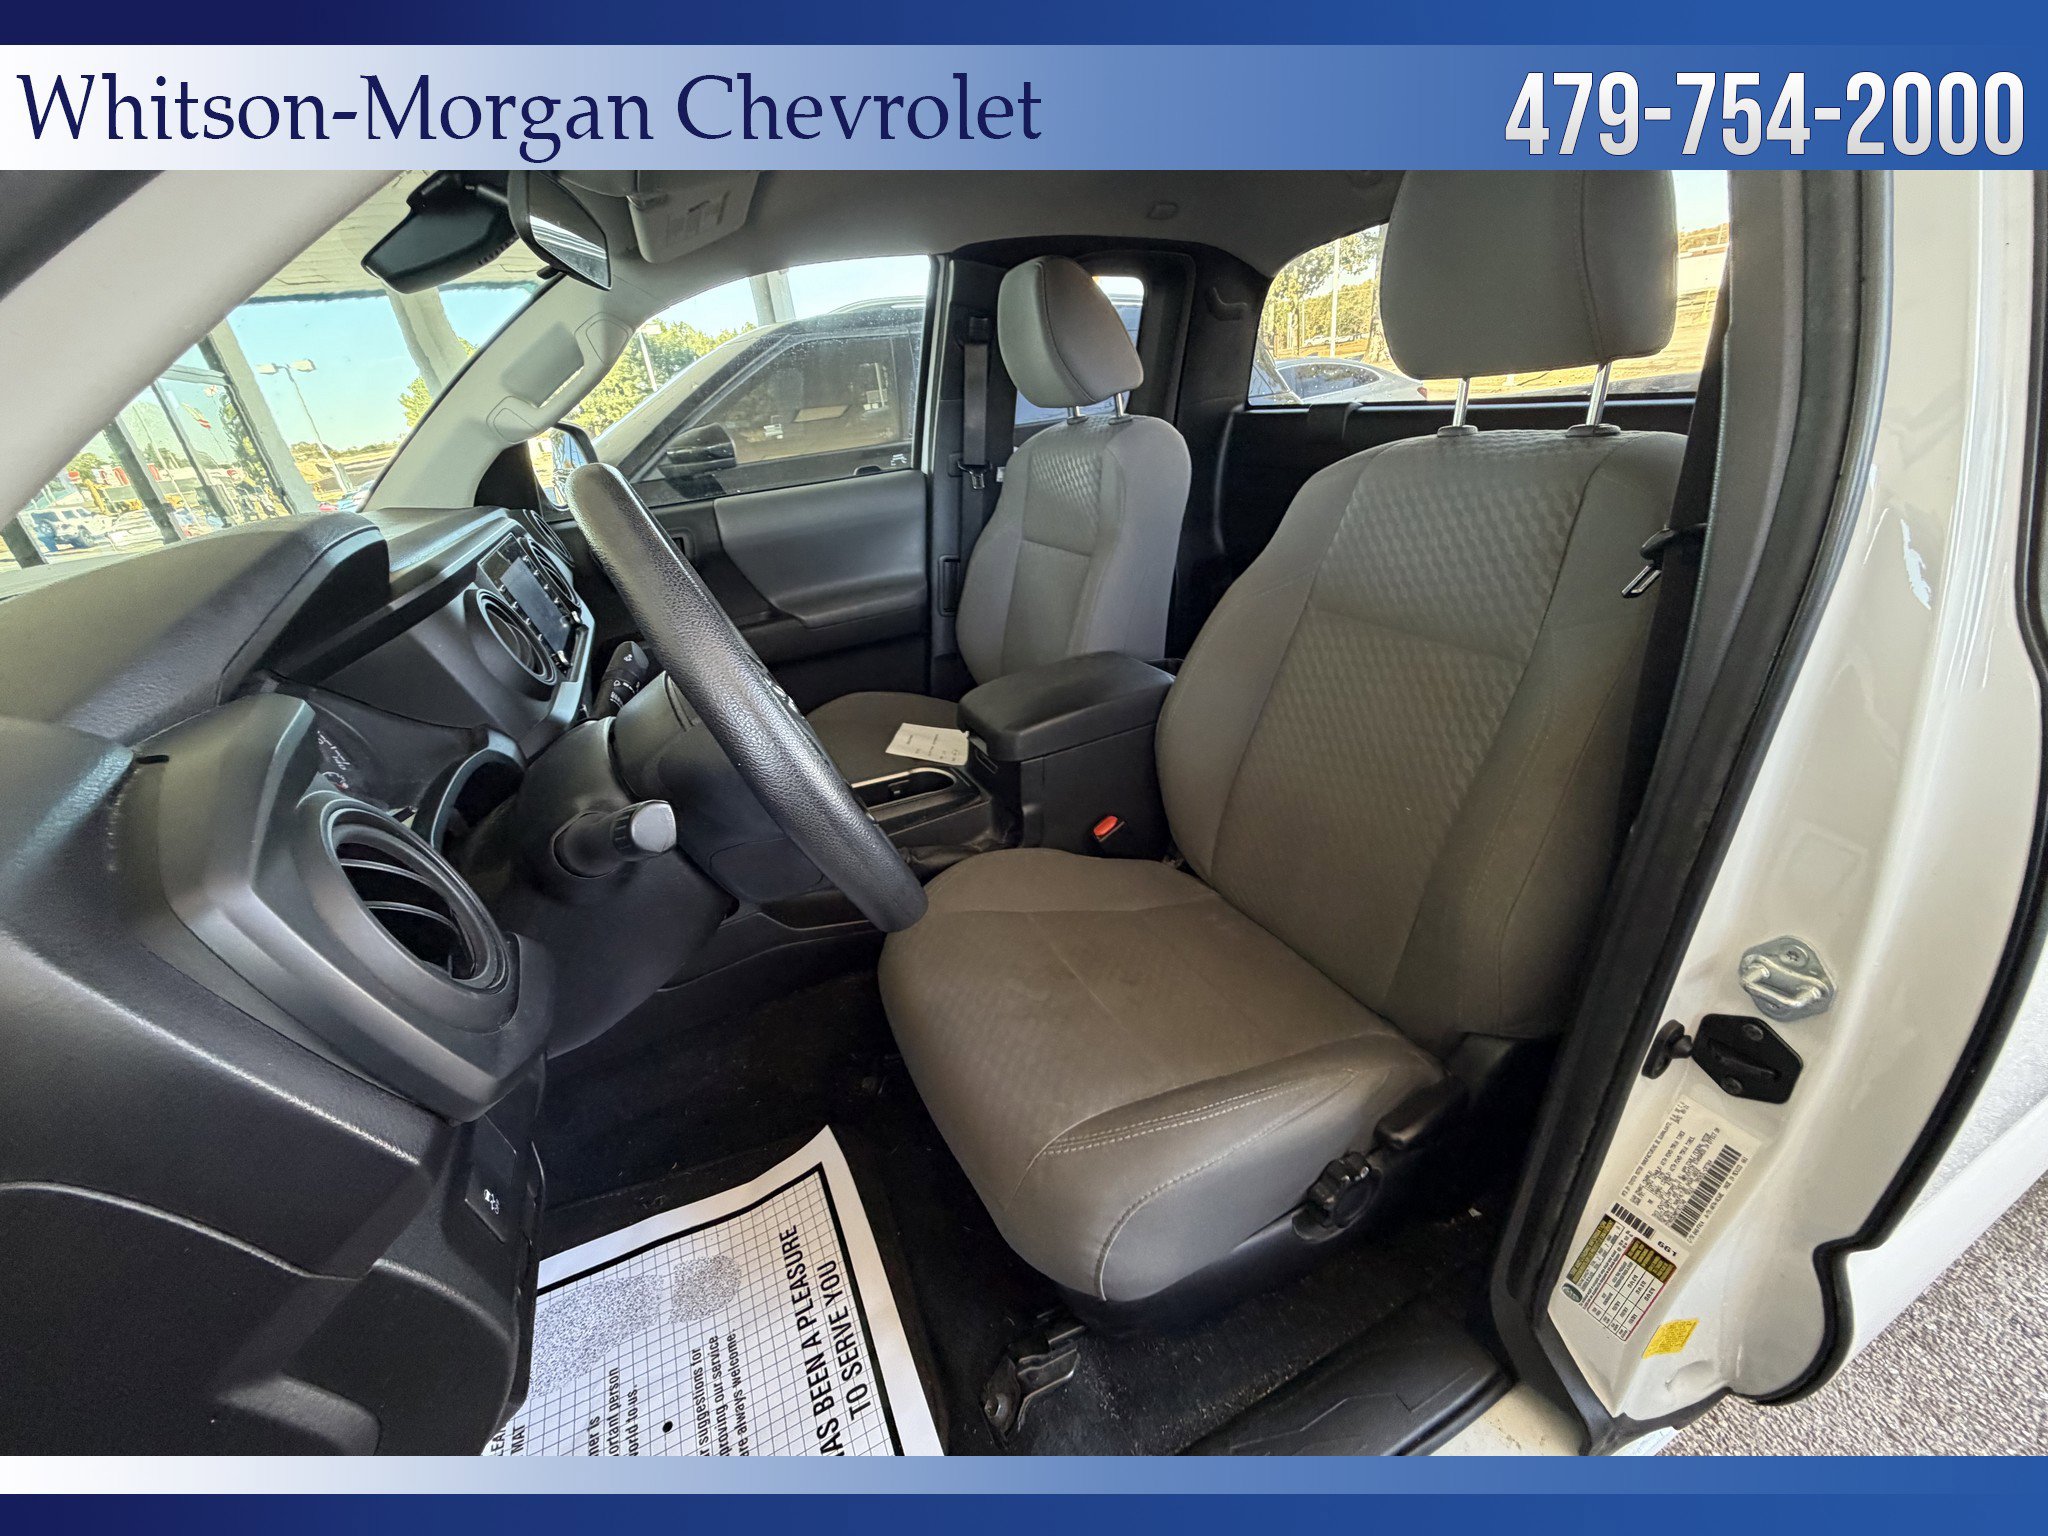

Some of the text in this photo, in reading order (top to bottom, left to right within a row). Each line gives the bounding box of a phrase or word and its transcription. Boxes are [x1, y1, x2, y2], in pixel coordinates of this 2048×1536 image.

[1656, 1240, 1677, 1256] 661
[779, 1225, 817, 1332] PLEASURE
[691, 1349, 703, 1367] for
[709, 1335, 722, 1379] service
[726, 1329, 742, 1388] welcome.
[801, 1331, 823, 1350] A
[817, 1260, 871, 1421] TO SERVE YOU
[609, 1367, 622, 1412] person
[712, 1382, 725, 1403] our
[805, 1352, 835, 1416] BEEN
[587, 1415, 600, 1431] is
[626, 1408, 638, 1423] to
[691, 1368, 711, 1446] suggestions
[733, 1388, 748, 1435] always
[511, 1424, 526, 1454] MAT
